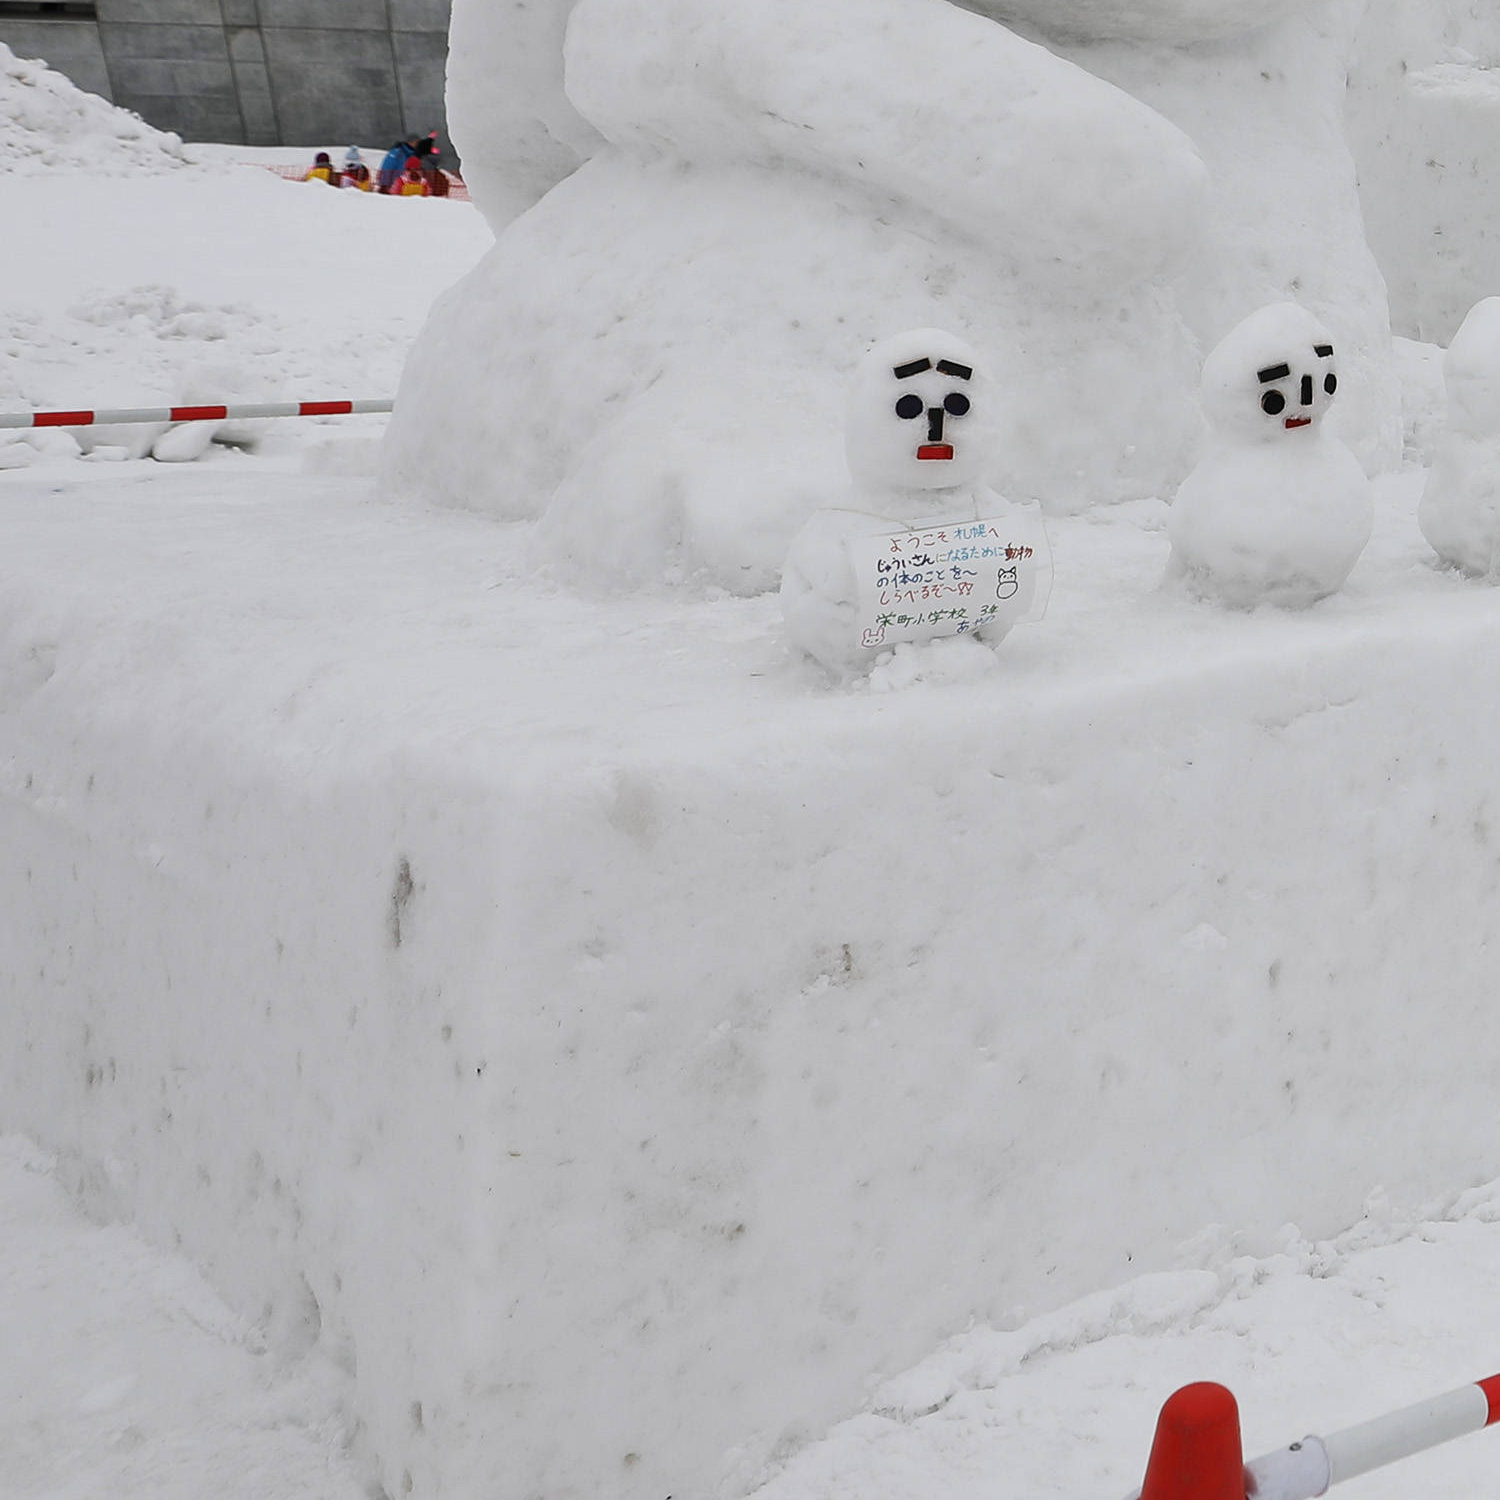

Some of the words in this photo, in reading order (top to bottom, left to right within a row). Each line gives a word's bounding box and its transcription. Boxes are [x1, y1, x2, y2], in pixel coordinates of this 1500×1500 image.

[875, 607, 969, 628] 栄町小学校
